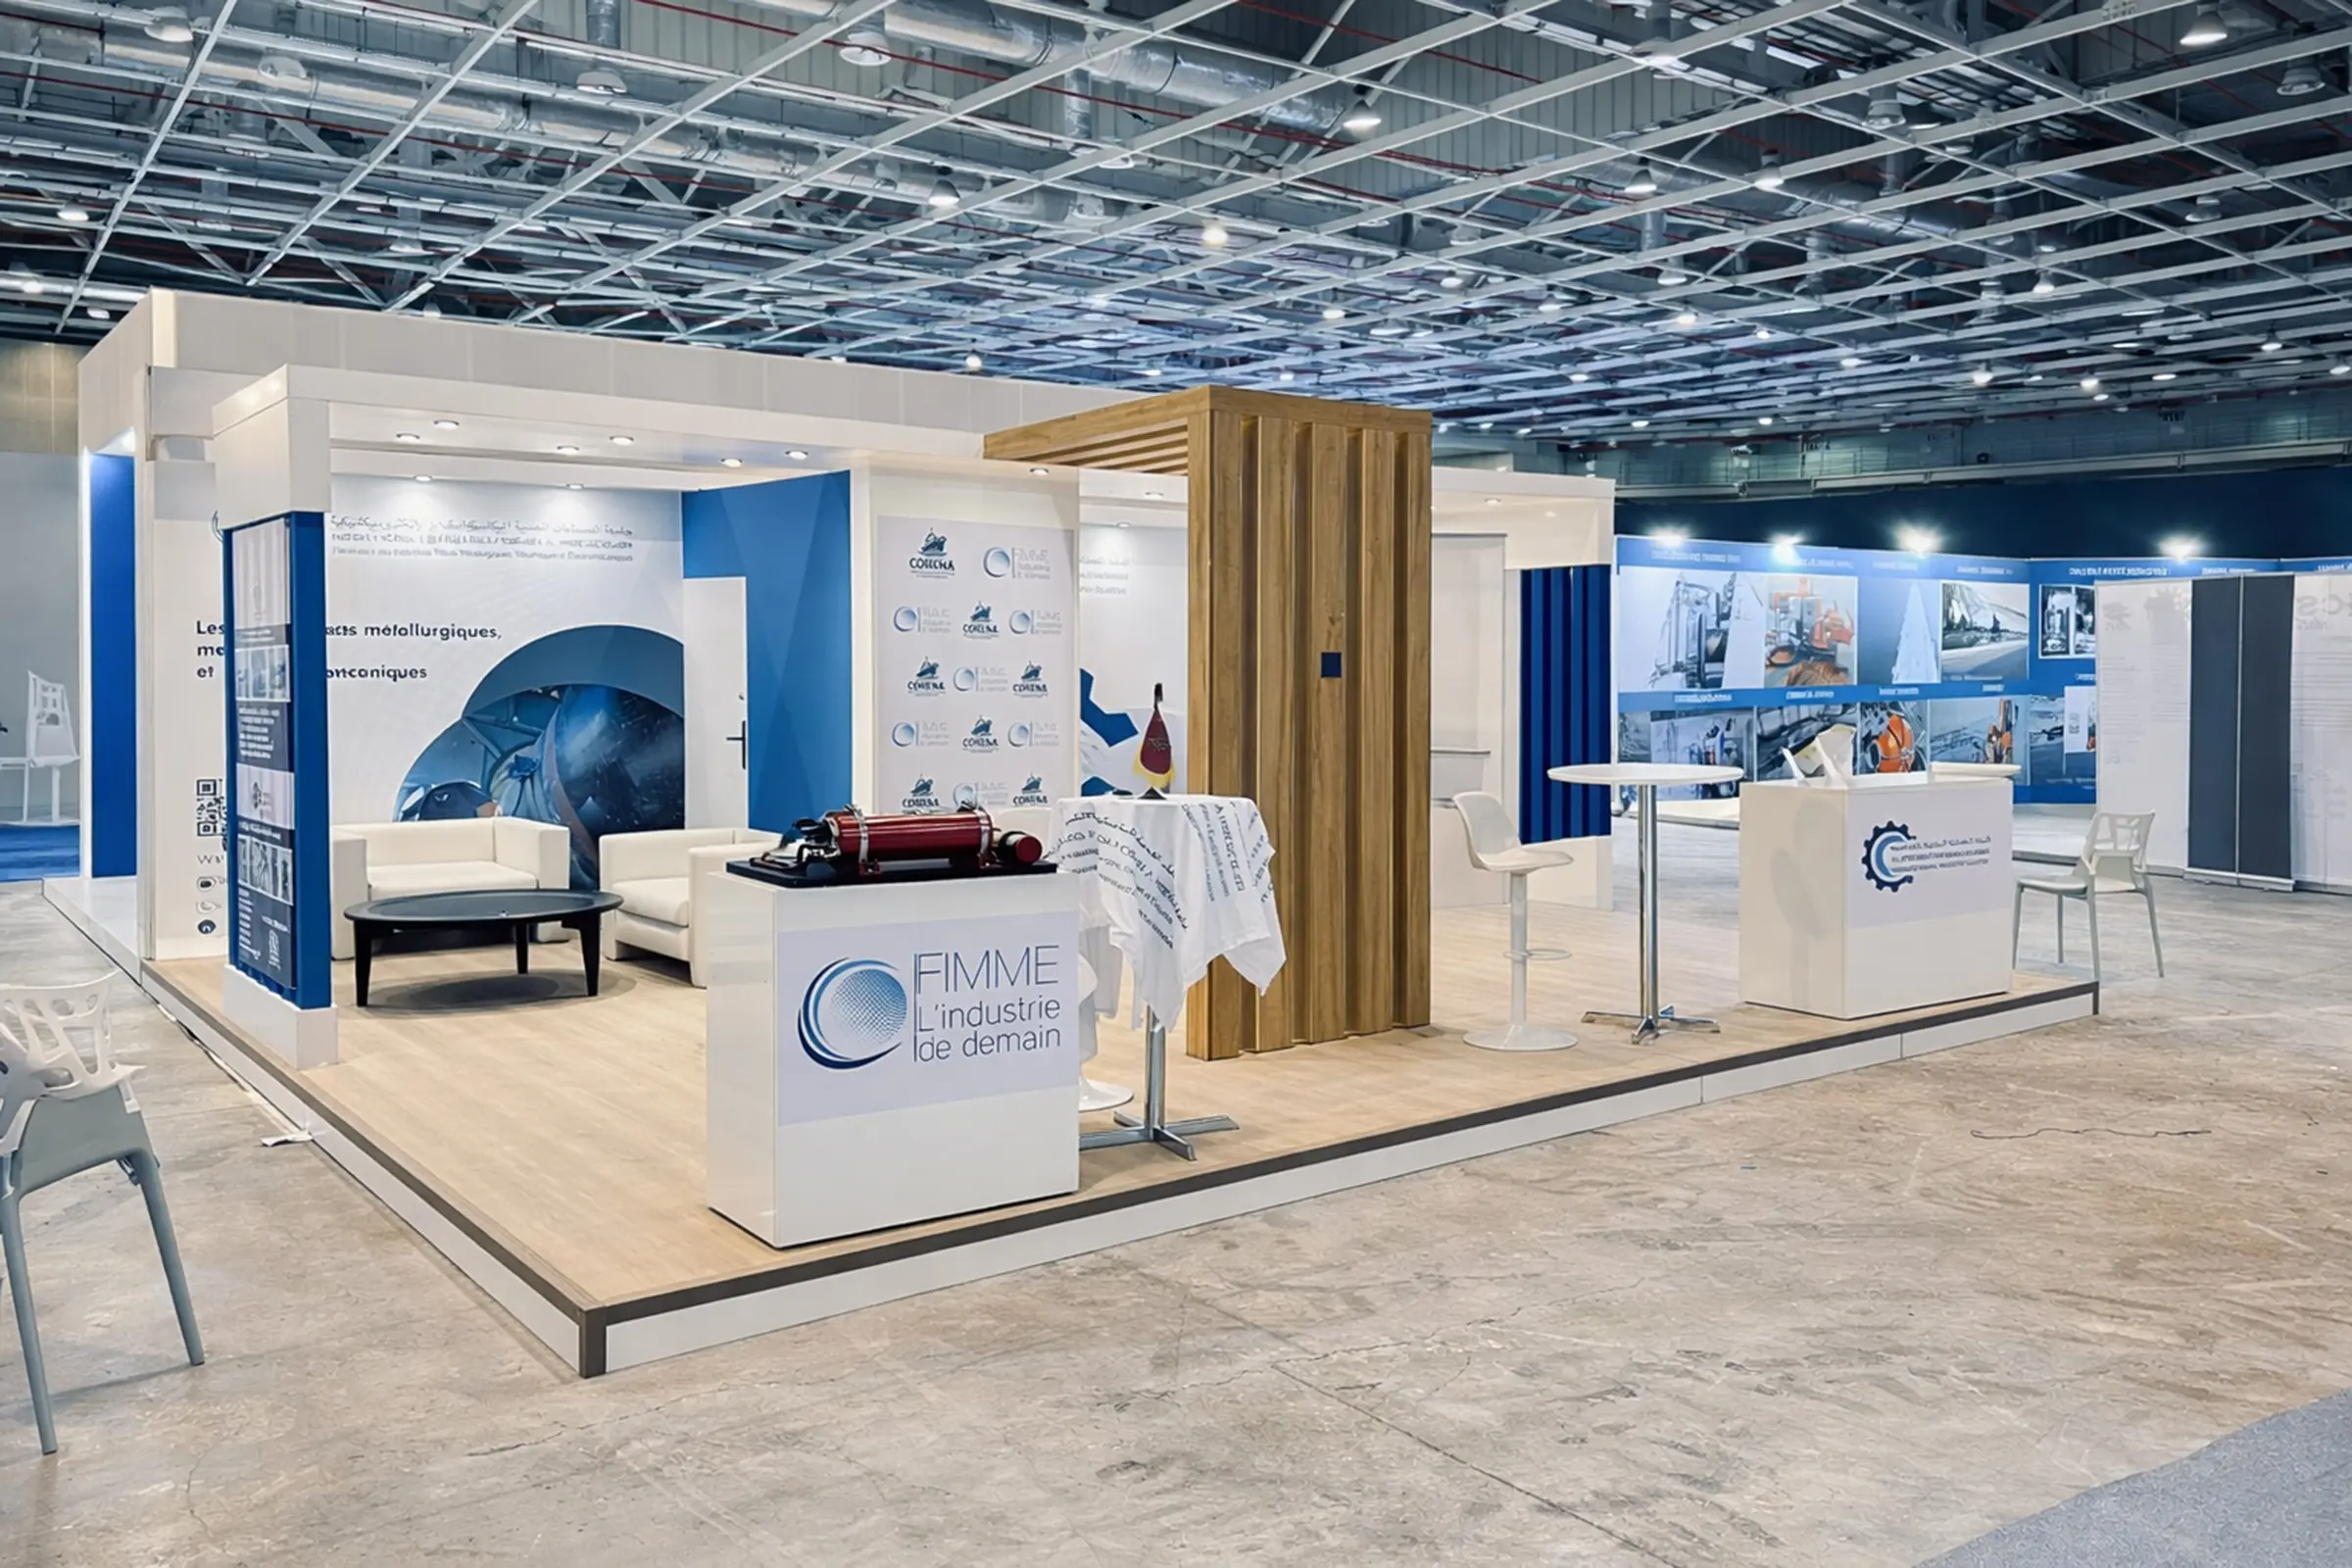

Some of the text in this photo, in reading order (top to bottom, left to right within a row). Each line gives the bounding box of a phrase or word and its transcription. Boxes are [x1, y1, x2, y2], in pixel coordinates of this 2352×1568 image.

[196, 619, 225, 635] Les
[917, 945, 1059, 994] FIMME
[918, 995, 1061, 1032] L'industrie
[918, 1025, 1061, 1062] de demain
